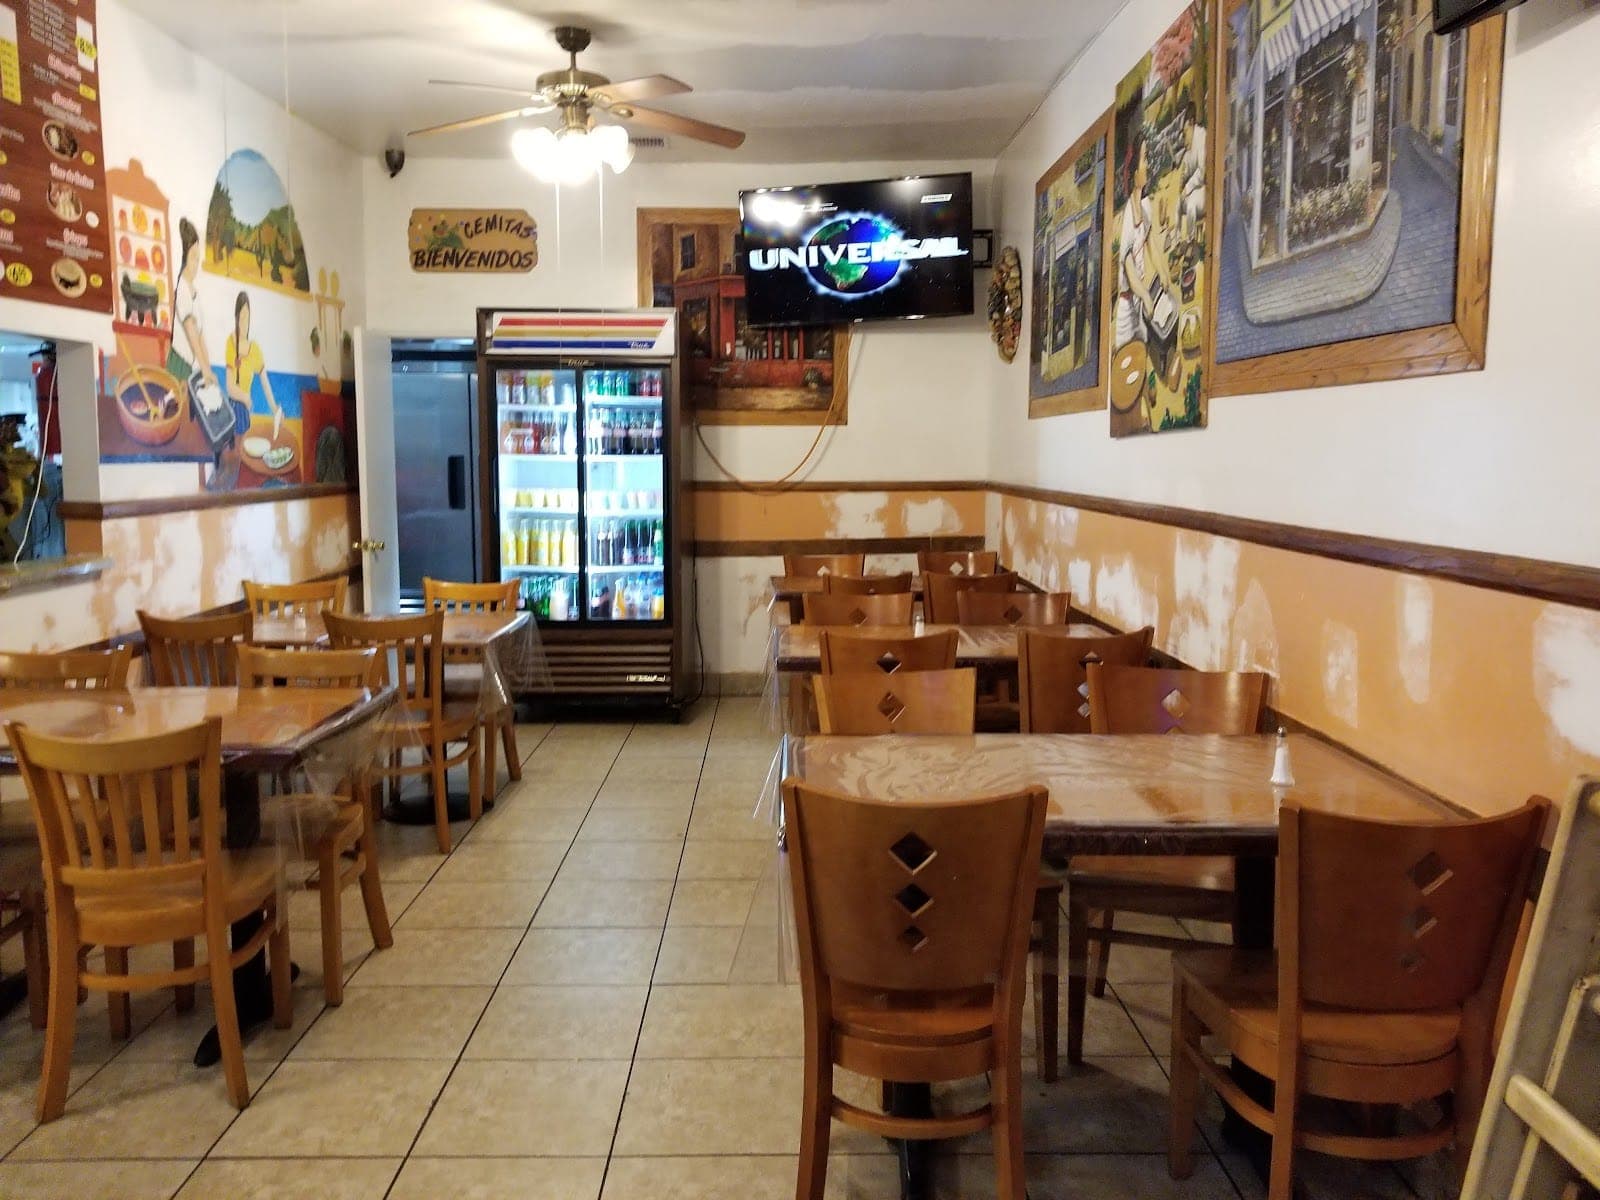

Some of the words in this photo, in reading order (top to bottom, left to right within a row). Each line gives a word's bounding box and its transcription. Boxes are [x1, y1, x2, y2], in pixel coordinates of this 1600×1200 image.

[464, 214, 535, 239] CEMITAS
[413, 247, 534, 269] BIENVENIDOS
[749, 236, 965, 271] UNIVERSAL
